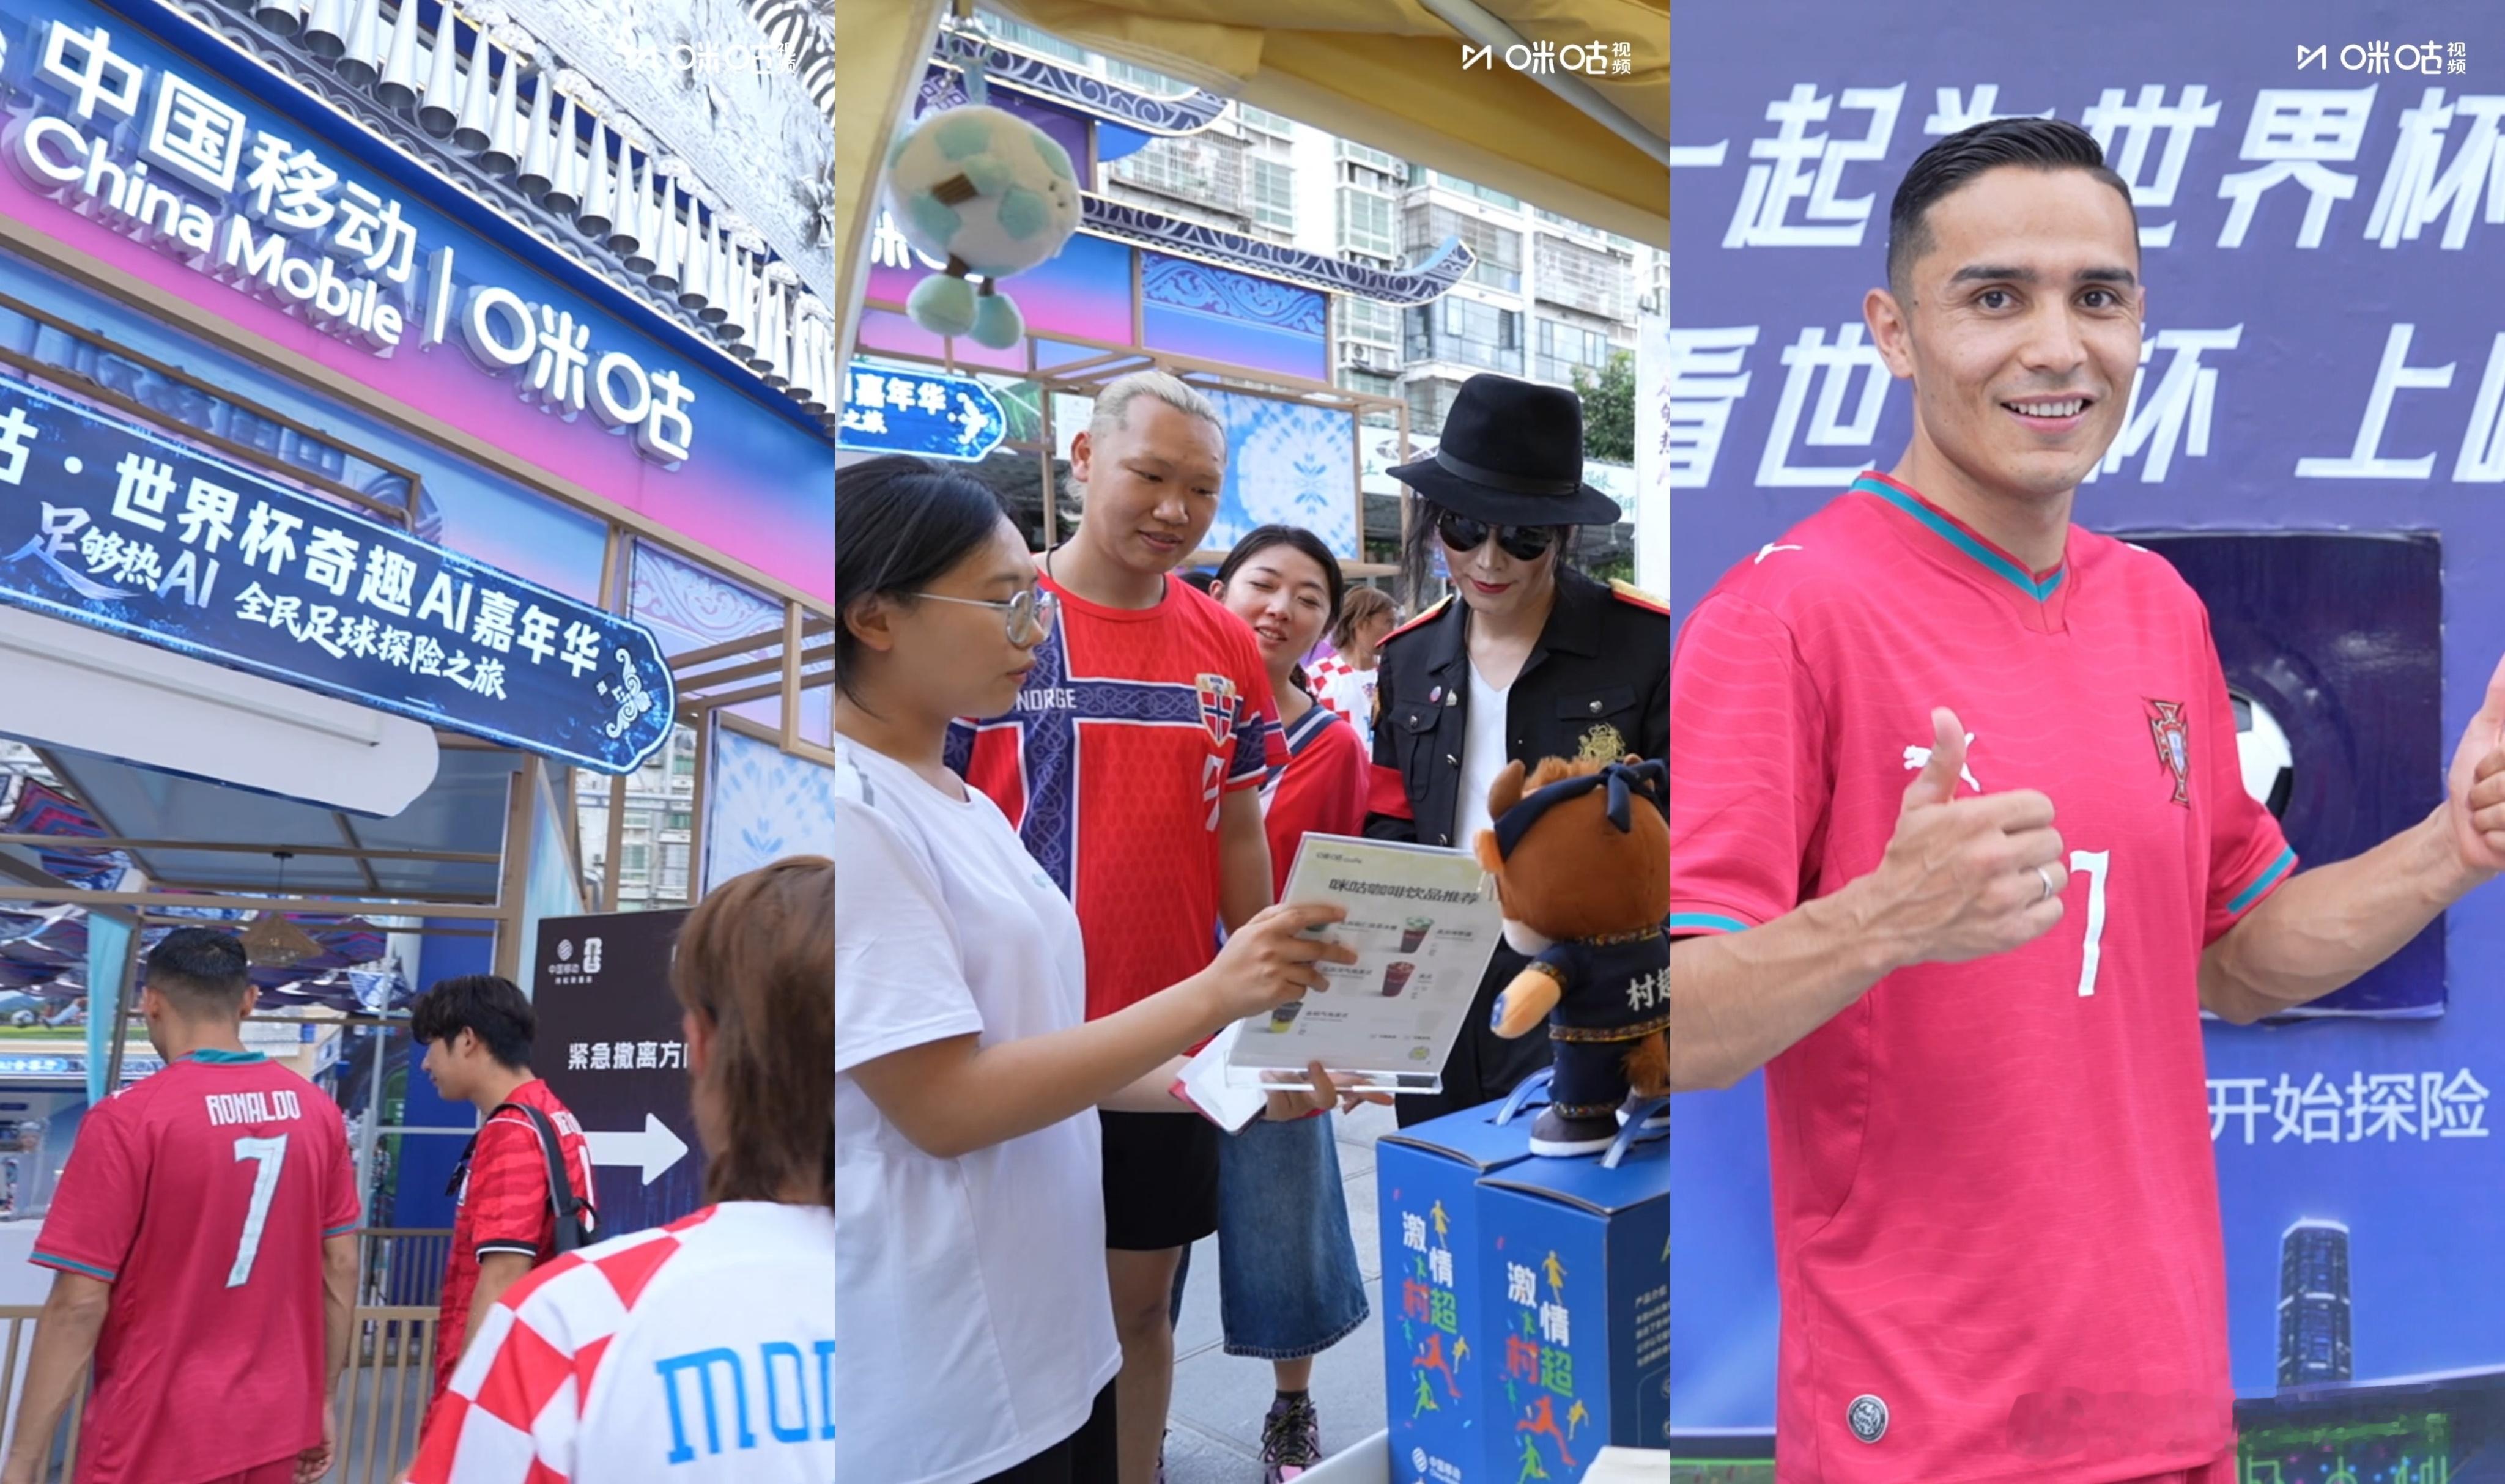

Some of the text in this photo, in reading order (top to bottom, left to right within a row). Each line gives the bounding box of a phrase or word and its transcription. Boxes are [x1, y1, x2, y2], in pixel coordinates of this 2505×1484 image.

[24, 117, 402, 345] China Mobile
[43, 20, 695, 461] 中国移动 咪咕
[3, 501, 220, 608] 足够热AI
[235, 581, 508, 701] 全民足球探险之旅
[1016, 688, 1078, 712] NORGE
[1328, 878, 1480, 905] 咪咕咖啡饮品推荐
[2070, 849, 2109, 997] 7
[205, 1090, 302, 1126] RONALDO
[568, 1040, 688, 1071] 紧急撤离方
[2205, 1068, 2490, 1144] 开始探险
[226, 1132, 289, 1288] 7
